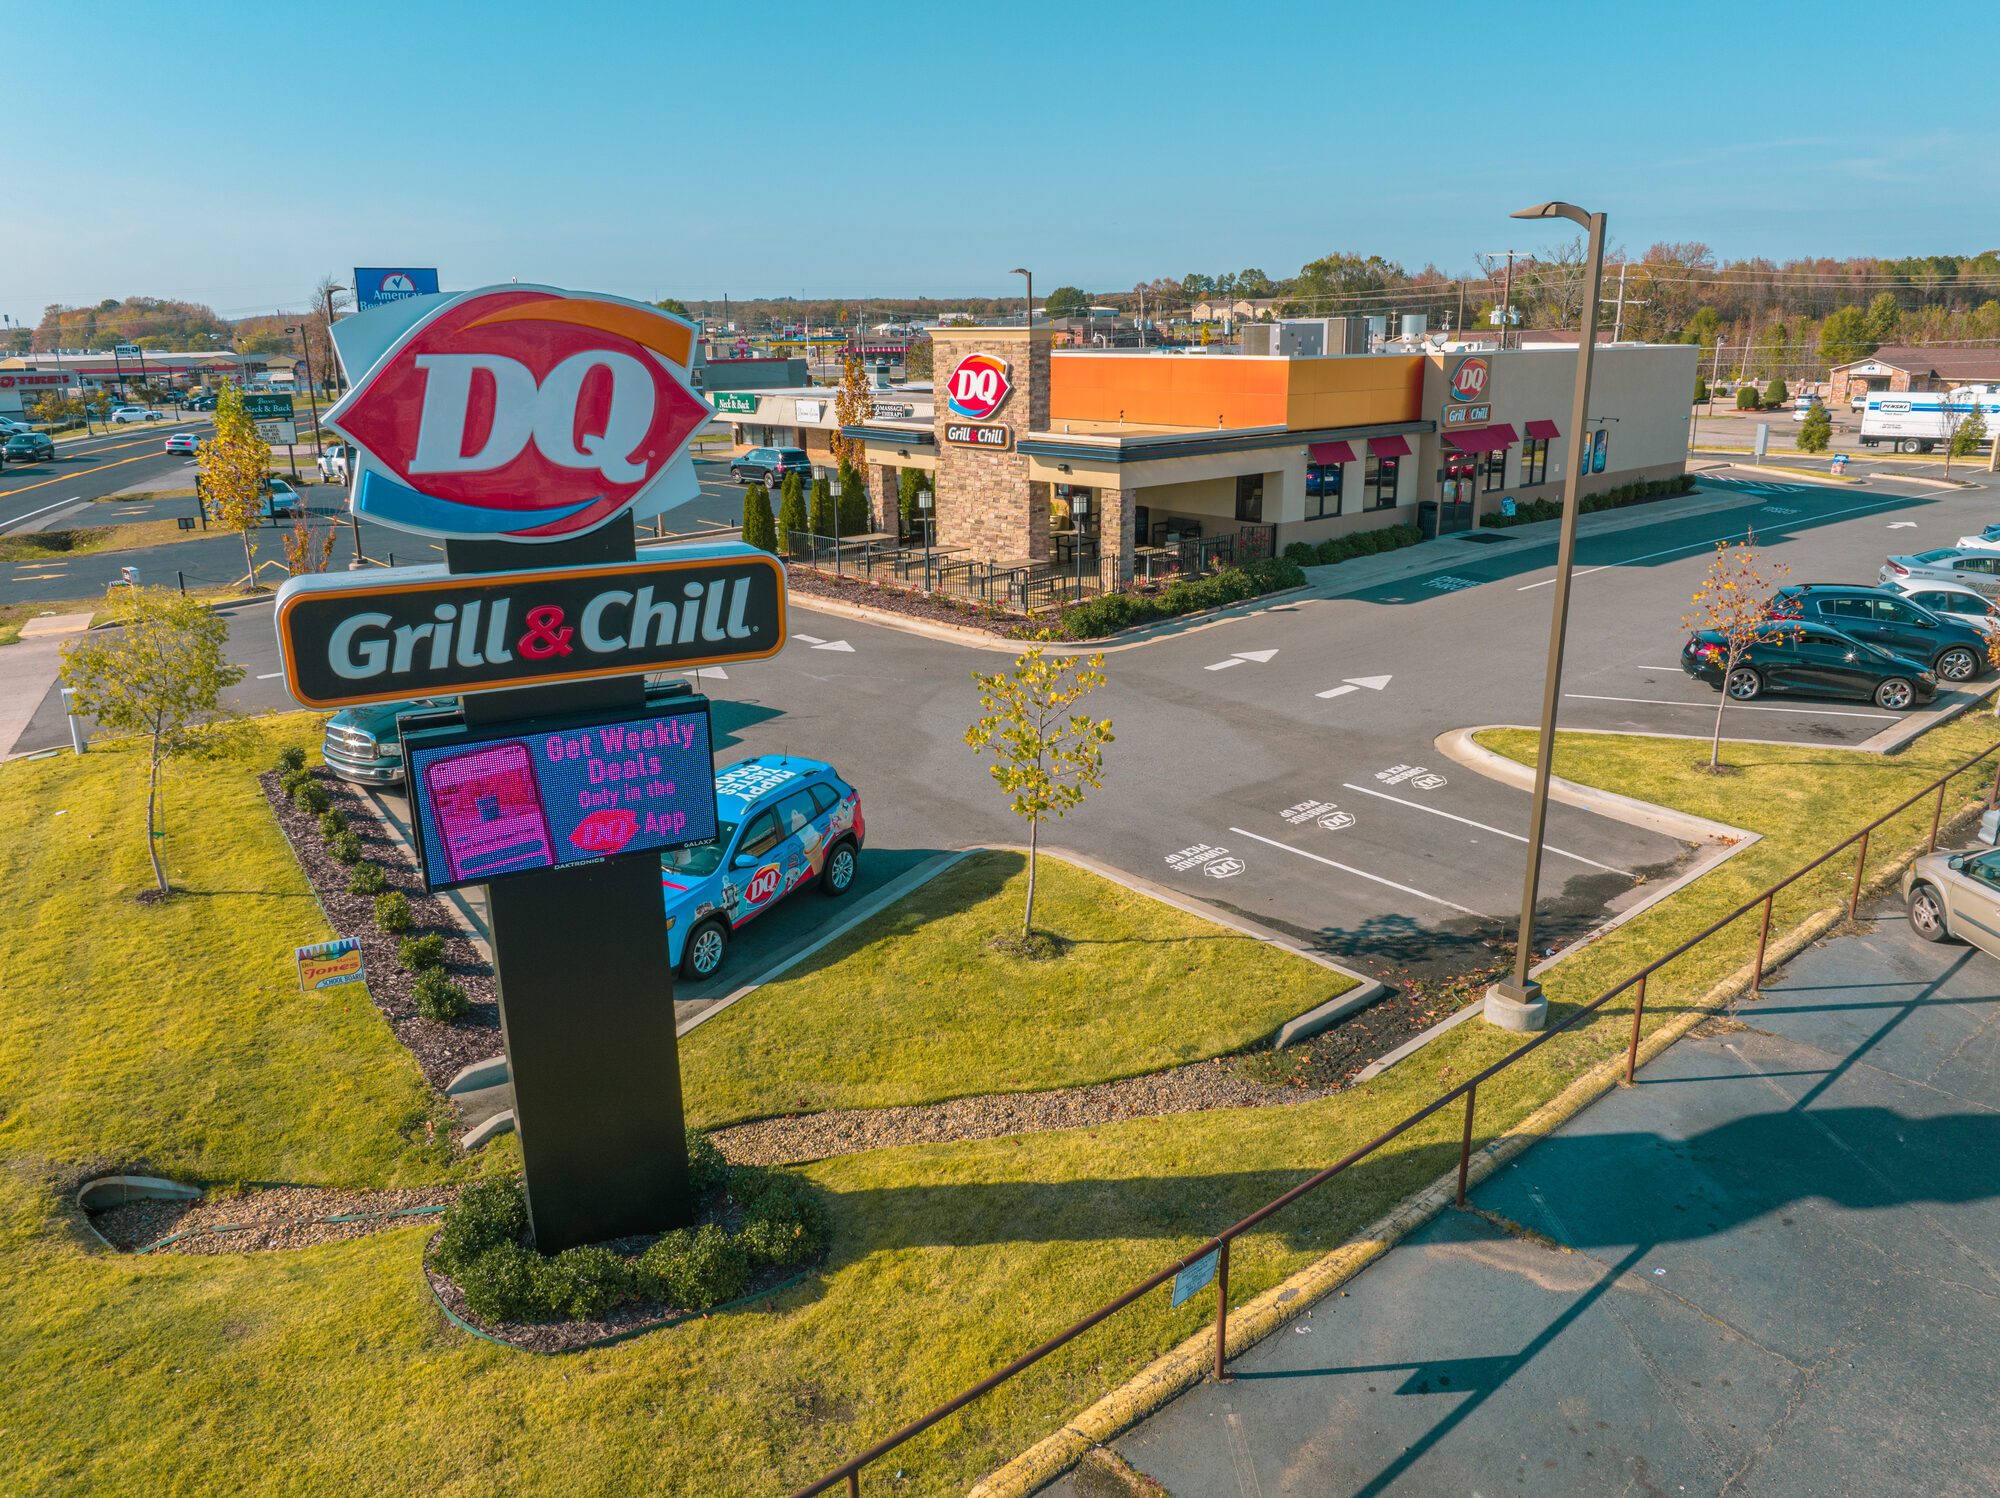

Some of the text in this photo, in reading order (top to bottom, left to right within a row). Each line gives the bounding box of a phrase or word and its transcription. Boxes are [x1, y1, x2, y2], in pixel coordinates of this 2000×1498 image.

[16, 375, 70, 384] TIRES
[956, 369, 998, 405] DQ
[1459, 367, 1484, 391] DQ
[273, 404, 292, 412] Back
[719, 399, 732, 408] Neck
[737, 399, 750, 409] Back
[408, 349, 657, 484] DQ
[546, 720, 696, 762] Get Weekly
[588, 752, 662, 784] Deals
[717, 768, 782, 795] TASTES
[735, 770, 797, 801] HAPPY
[578, 787, 620, 808] Only
[647, 780, 675, 797] the
[644, 811, 686, 836] App
[684, 839, 713, 848] GALAXY
[1164, 843, 1211, 863] PICK UP
[554, 857, 606, 870] DAKTRONICS
[1169, 847, 1229, 872] CURBSIDE
[1206, 860, 1242, 875] DQ
[751, 870, 777, 900] DQ
[303, 961, 359, 979] Jones
[322, 974, 362, 986] SCHOOL BOARD
